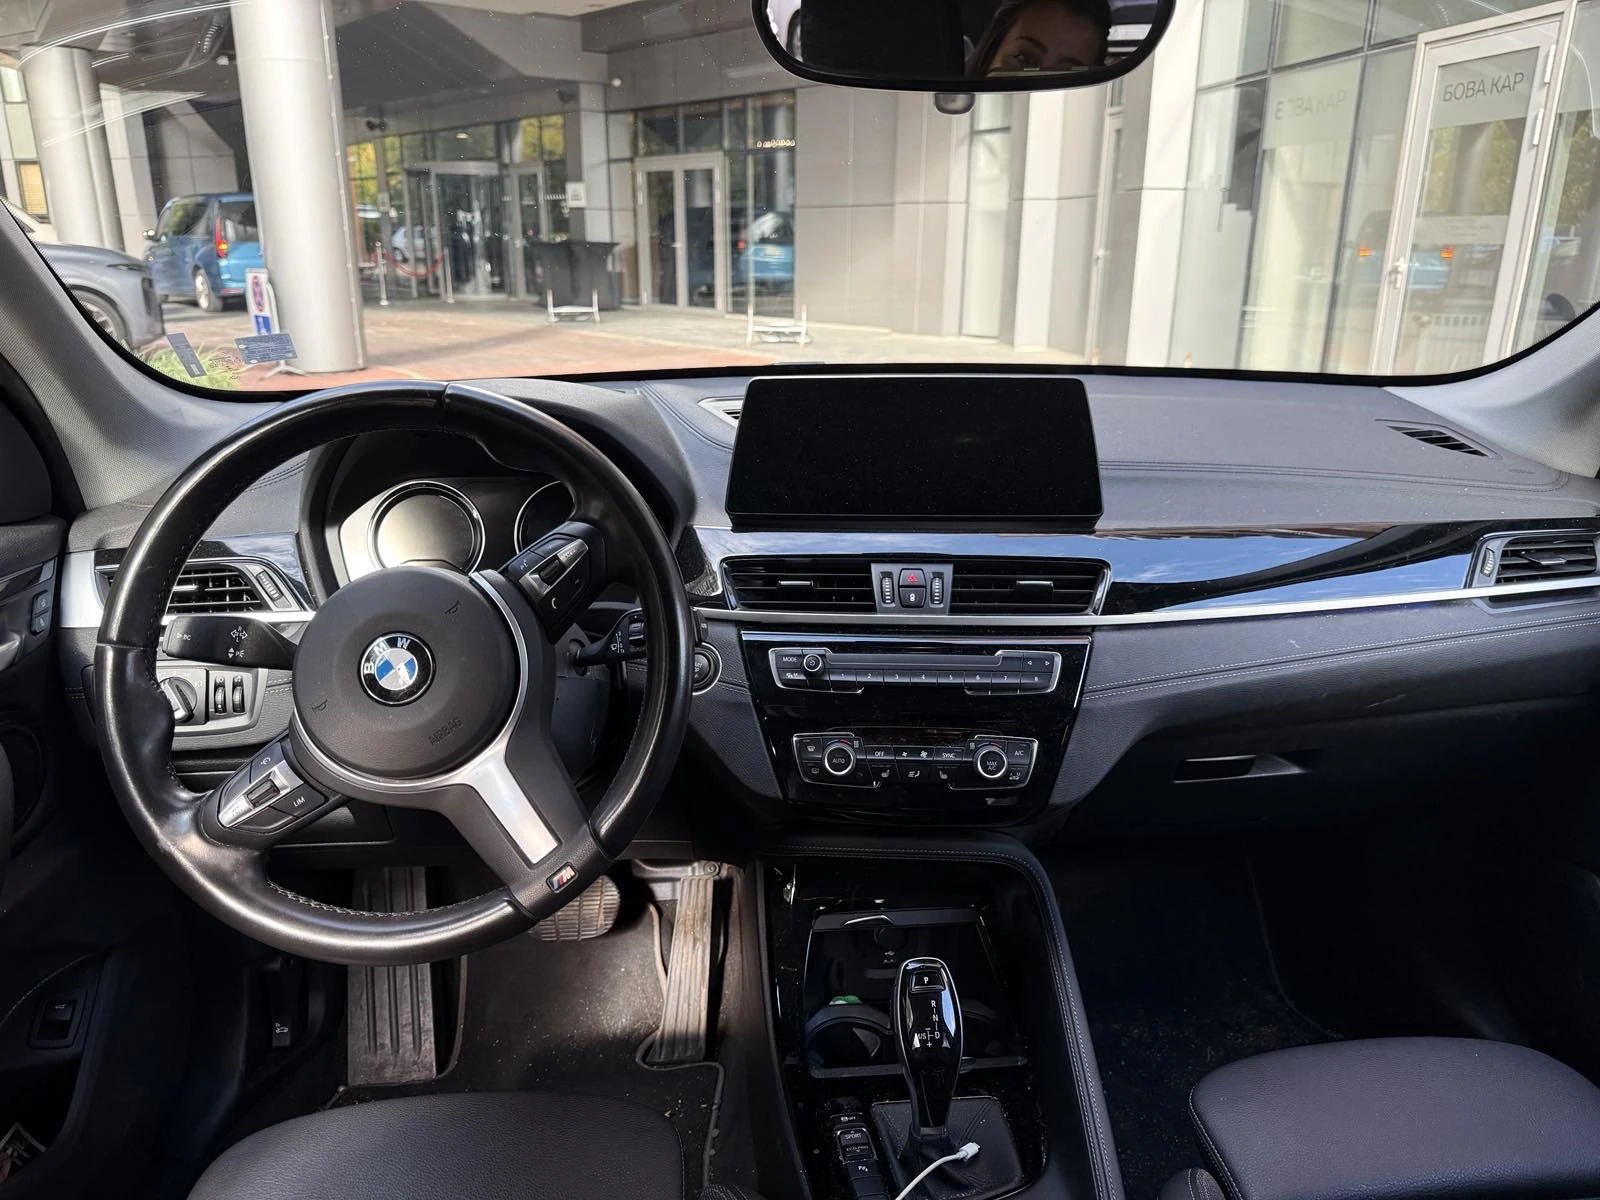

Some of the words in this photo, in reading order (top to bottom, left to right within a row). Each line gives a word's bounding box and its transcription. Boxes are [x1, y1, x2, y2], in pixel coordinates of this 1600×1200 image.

[1443, 80, 1486, 102] БОВА
[1490, 72, 1525, 95] КАР
[363, 637, 411, 675] BMW
[293, 796, 306, 808] LIM
[923, 976, 929, 985] P
[931, 1000, 937, 1008] R
[932, 1014, 939, 1022] N
[934, 1031, 941, 1039] D
[844, 1132, 862, 1140] SPORT
